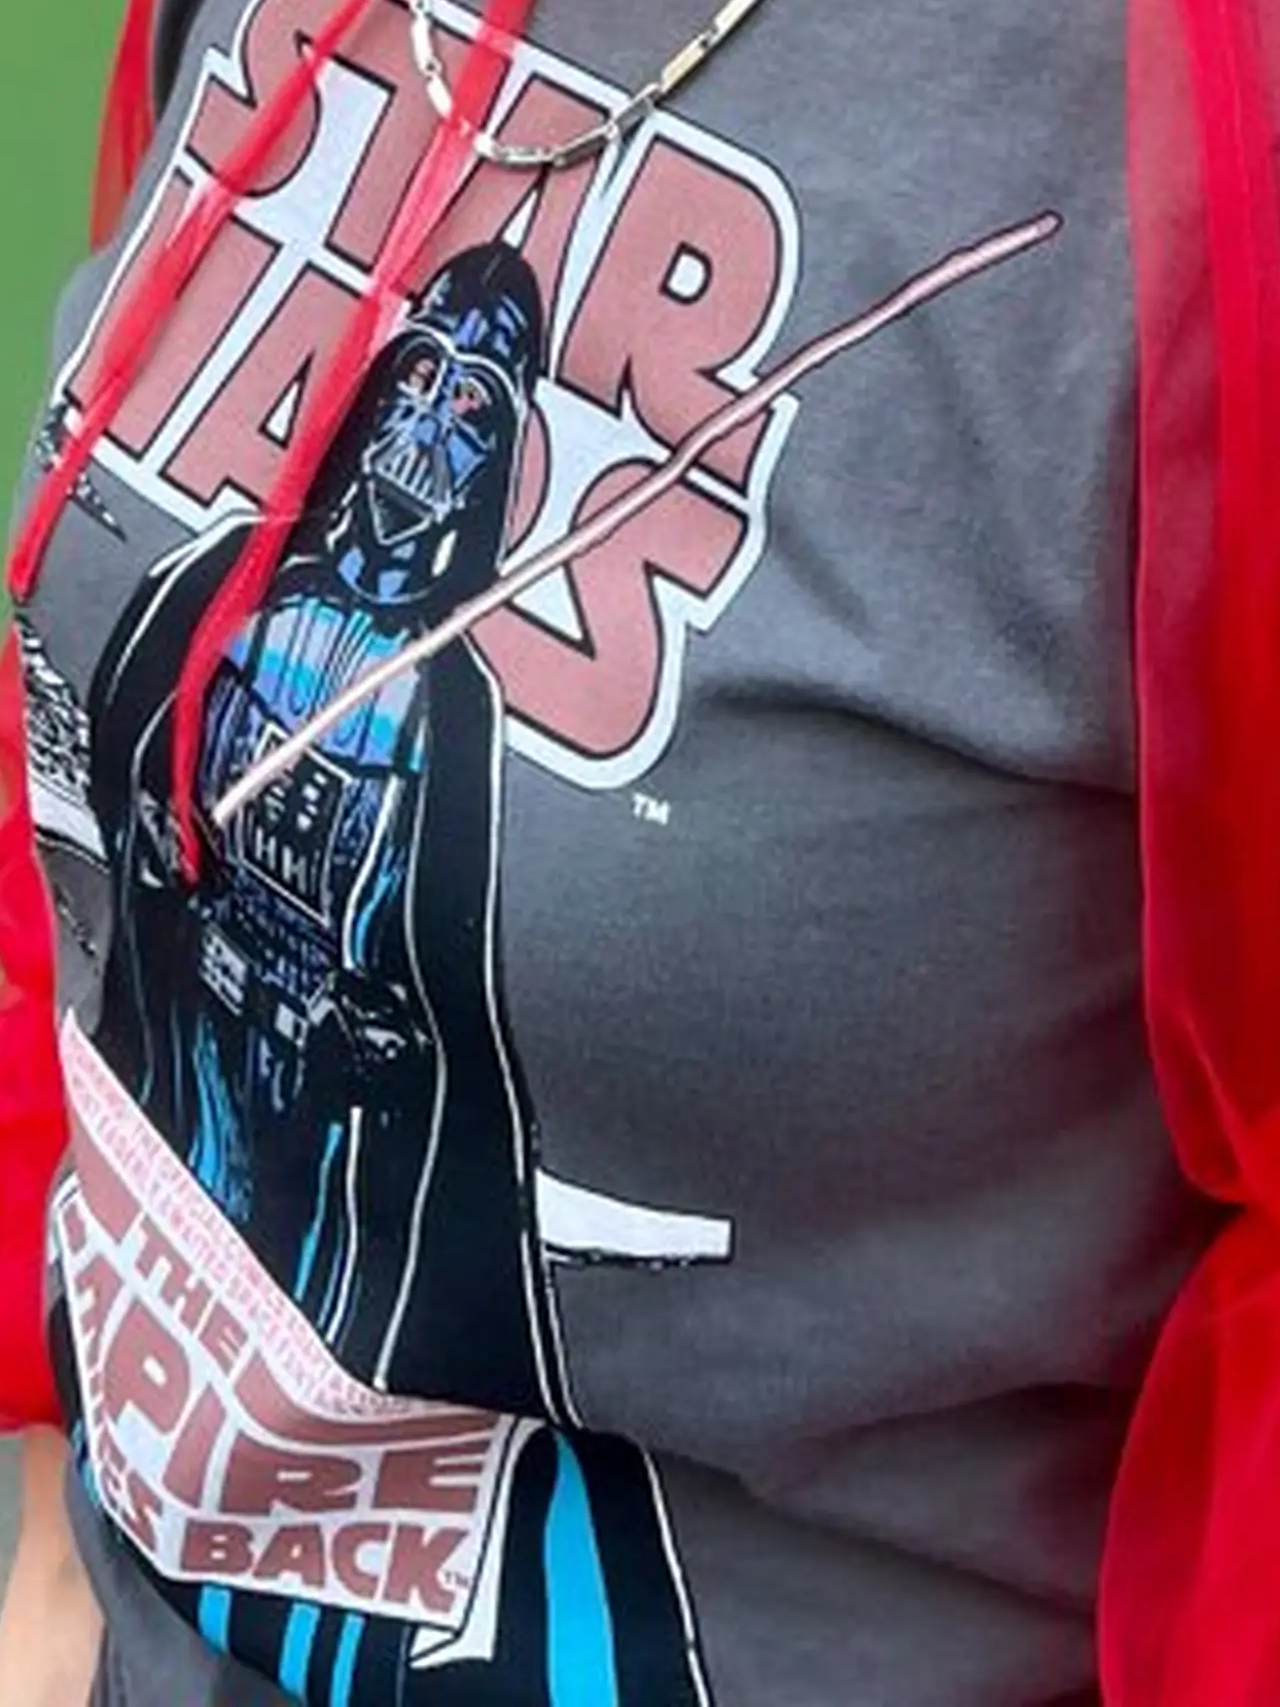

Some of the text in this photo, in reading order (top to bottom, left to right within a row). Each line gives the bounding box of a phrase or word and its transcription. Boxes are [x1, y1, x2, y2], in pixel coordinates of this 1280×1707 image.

[65, 162, 752, 759] WAS
[60, 1203, 491, 1515] MPIRE
[134, 1214, 248, 1372] THE
[179, 1517, 470, 1614] BACK
